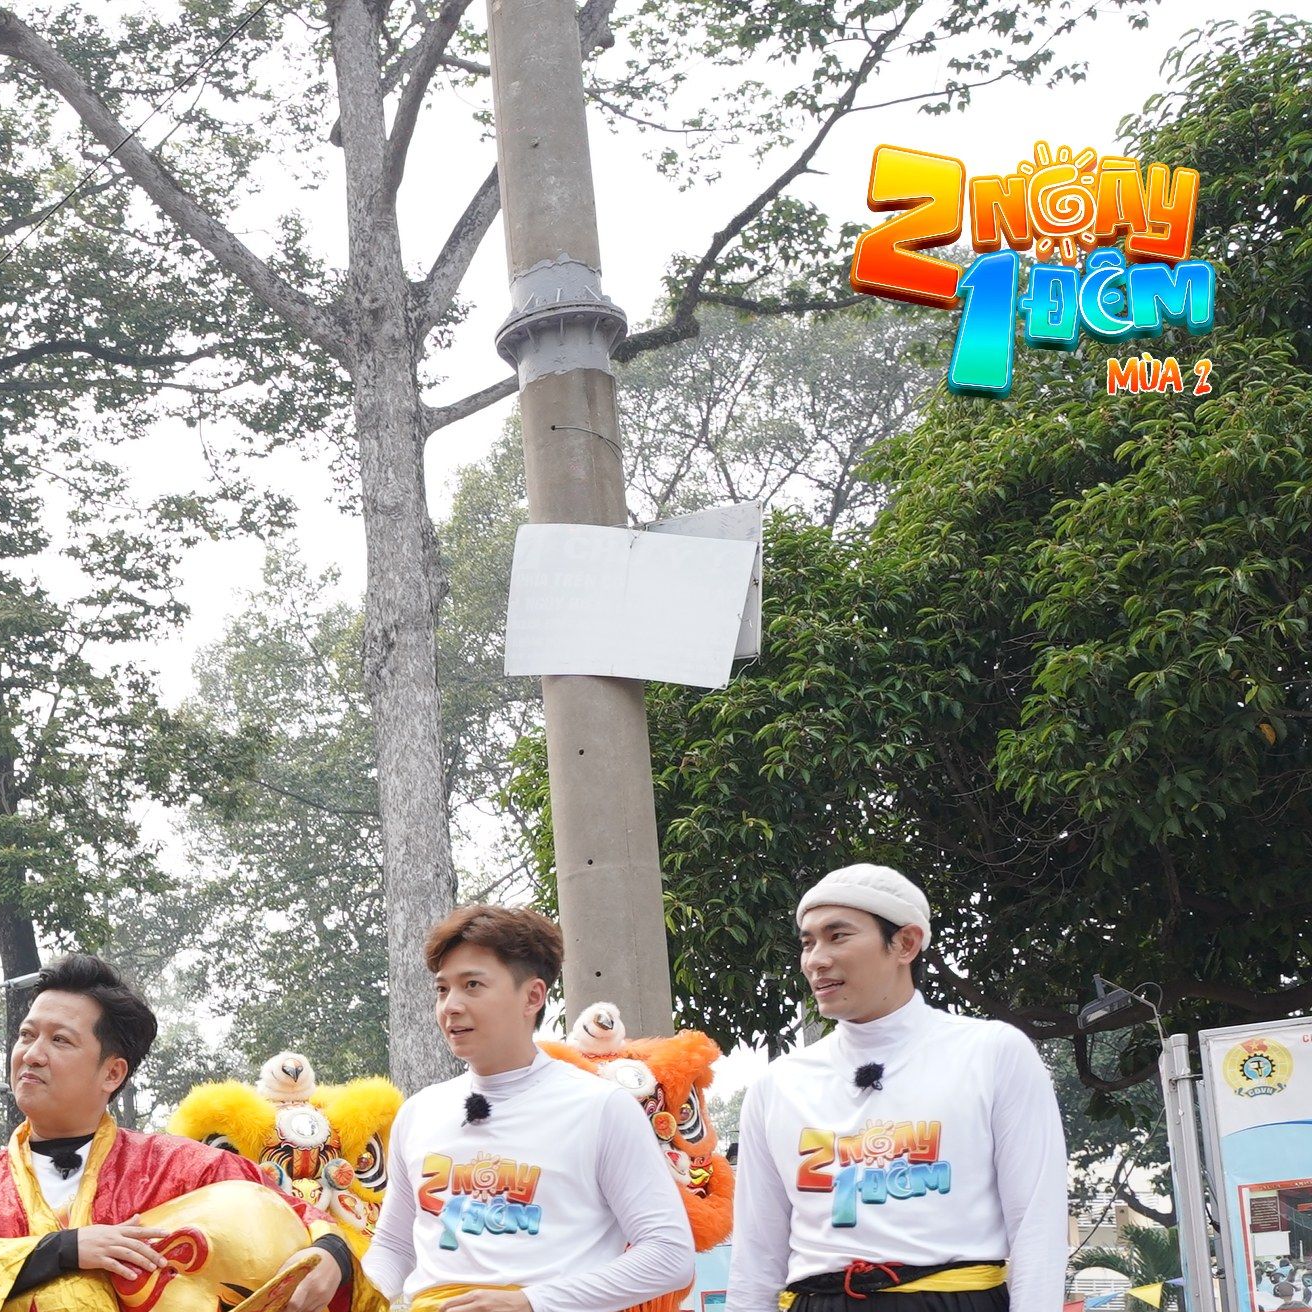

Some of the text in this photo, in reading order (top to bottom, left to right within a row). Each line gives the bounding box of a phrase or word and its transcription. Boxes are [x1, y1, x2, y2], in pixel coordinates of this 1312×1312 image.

[418, 1152, 453, 1216] 2
[797, 1127, 835, 1192] 2
[832, 1166, 857, 1228] 1
